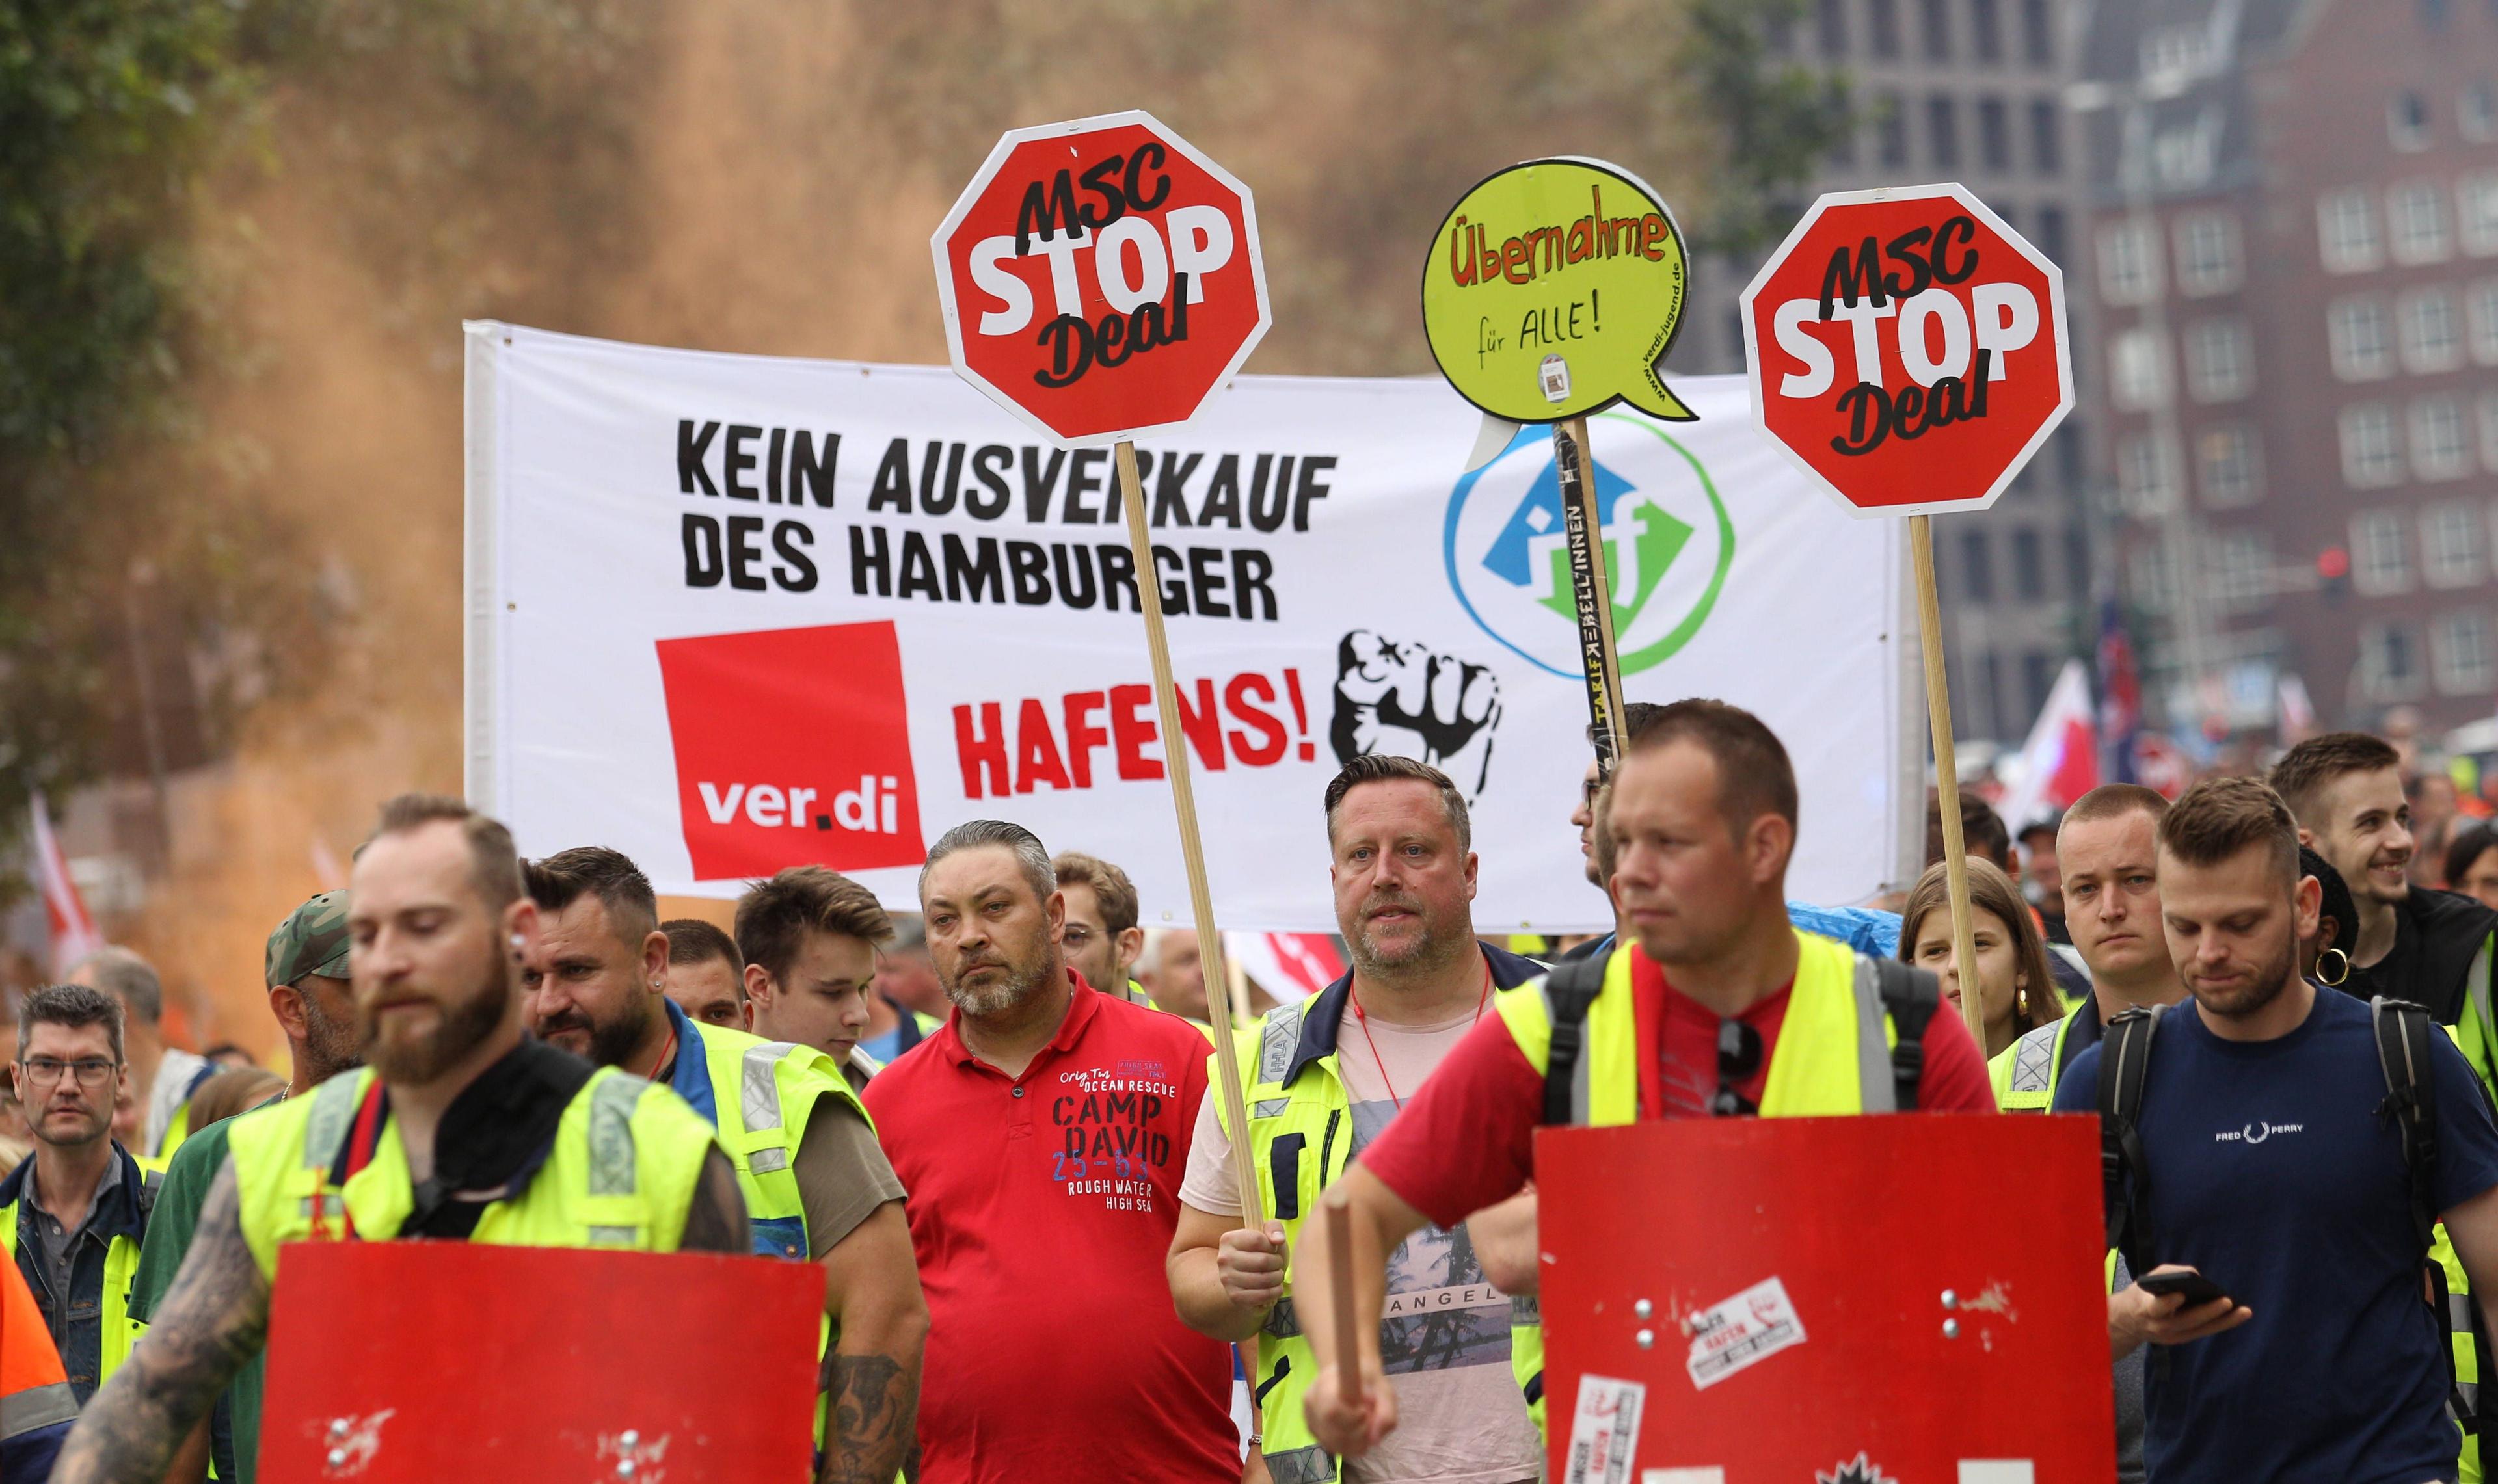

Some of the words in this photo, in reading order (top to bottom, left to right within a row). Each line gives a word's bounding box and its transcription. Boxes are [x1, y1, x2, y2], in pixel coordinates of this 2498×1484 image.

[1015, 143, 1170, 256] MSC
[1450, 185, 1669, 287] Übernahme
[969, 205, 1233, 336] STOP
[1819, 216, 1979, 320] MSC
[1034, 272, 1189, 388] Deal
[1478, 316, 1505, 369] für
[1643, 263, 1680, 402] www.verdi-jugend.de
[1773, 282, 2039, 398] STOP
[1831, 348, 1991, 456] Deal
[677, 419, 841, 507] KEIN
[868, 438, 1338, 532] AUSVERKAUF
[682, 514, 818, 592] DES
[848, 526, 1278, 620] HAMBURGER
[952, 668, 1314, 800] HAFENS!
[697, 775, 898, 835] ver.di
[1060, 1071, 1089, 1087] Orig.
[1084, 1080, 1123, 1093] OCEAN
[1129, 1080, 1175, 1098] RESCUE
[1270, 1040, 1286, 1073] HHLA
[1053, 1092, 1161, 1127] CAMP
[1066, 1126, 1170, 1167] DAVID
[2216, 1132, 2241, 1141] FRED
[2271, 1124, 2303, 1134] PERRY
[1068, 1179, 1110, 1196] ROUGH
[1115, 1180, 1152, 1197] WATER
[1107, 1197, 1132, 1211] HIGH
[1136, 1199, 1152, 1213] SEA
